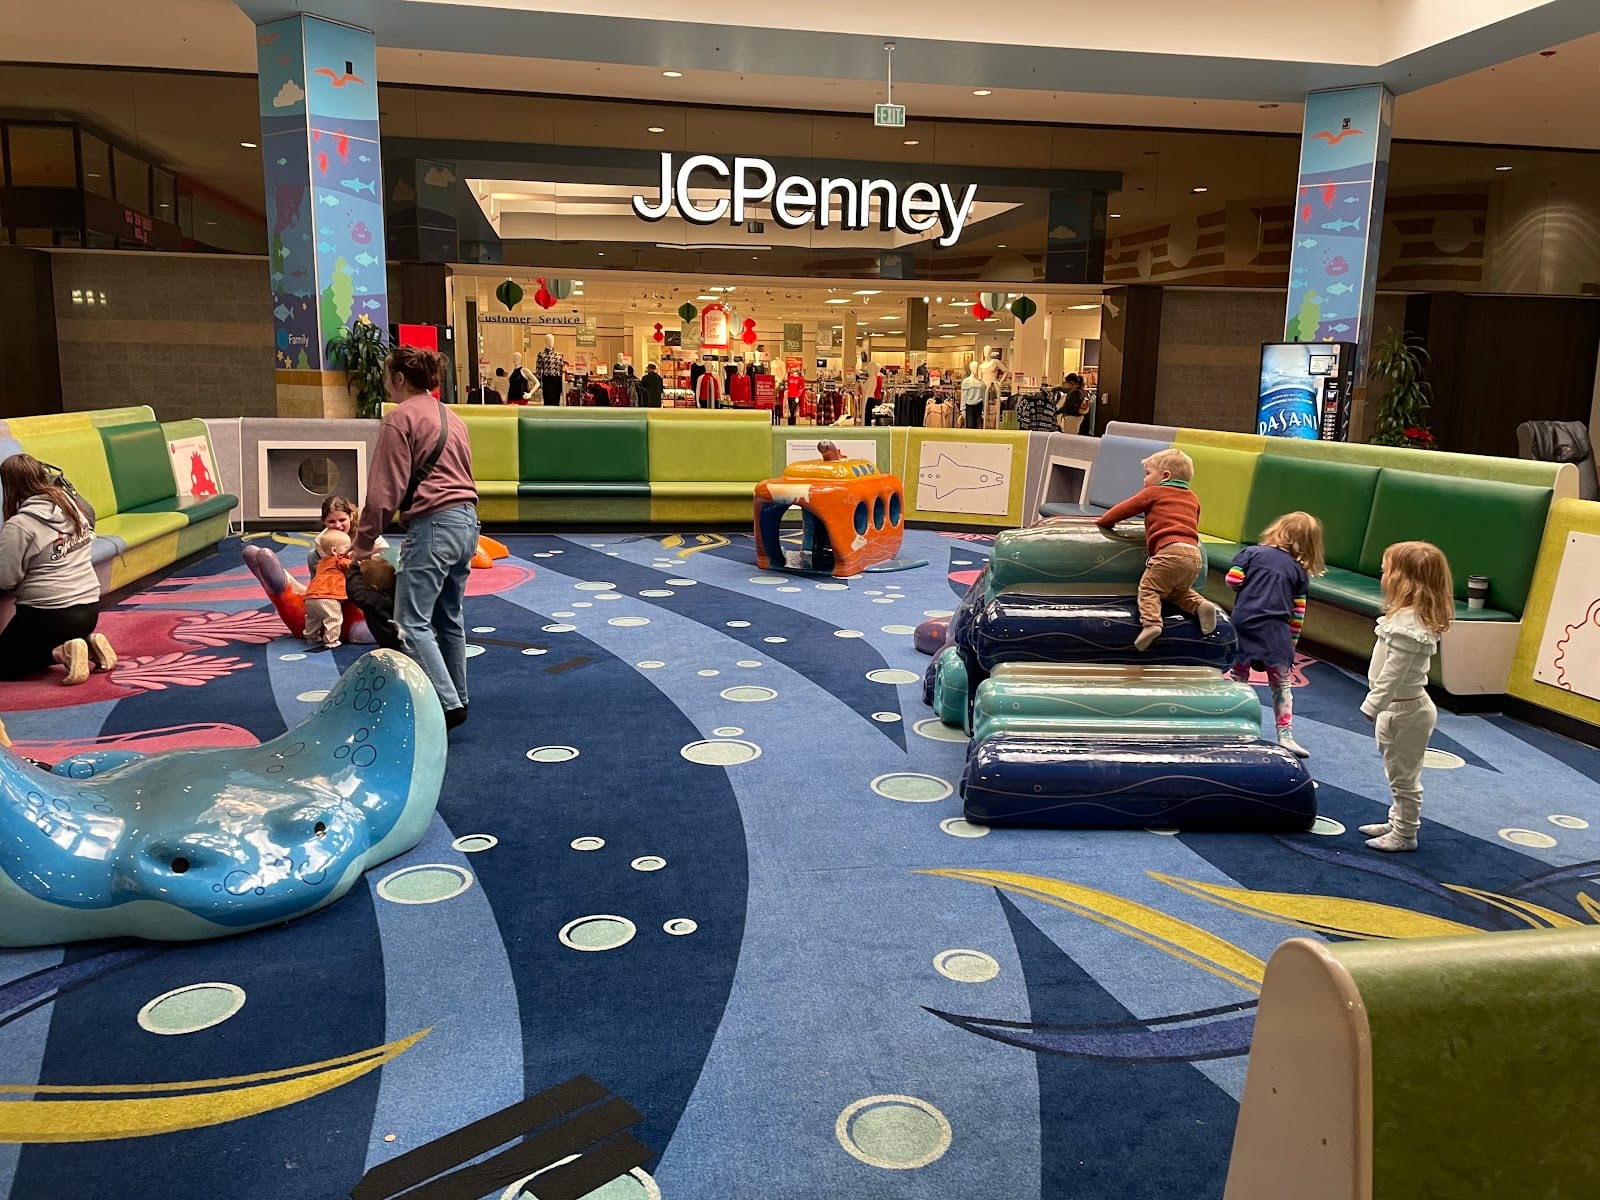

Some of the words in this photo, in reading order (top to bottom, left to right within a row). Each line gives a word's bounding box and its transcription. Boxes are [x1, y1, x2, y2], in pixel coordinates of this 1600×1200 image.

[880, 106, 902, 125] EXIT
[632, 152, 978, 248] JCPenney
[539, 314, 581, 324] Service
[288, 333, 310, 348] Family
[1260, 408, 1318, 436] DASANI
